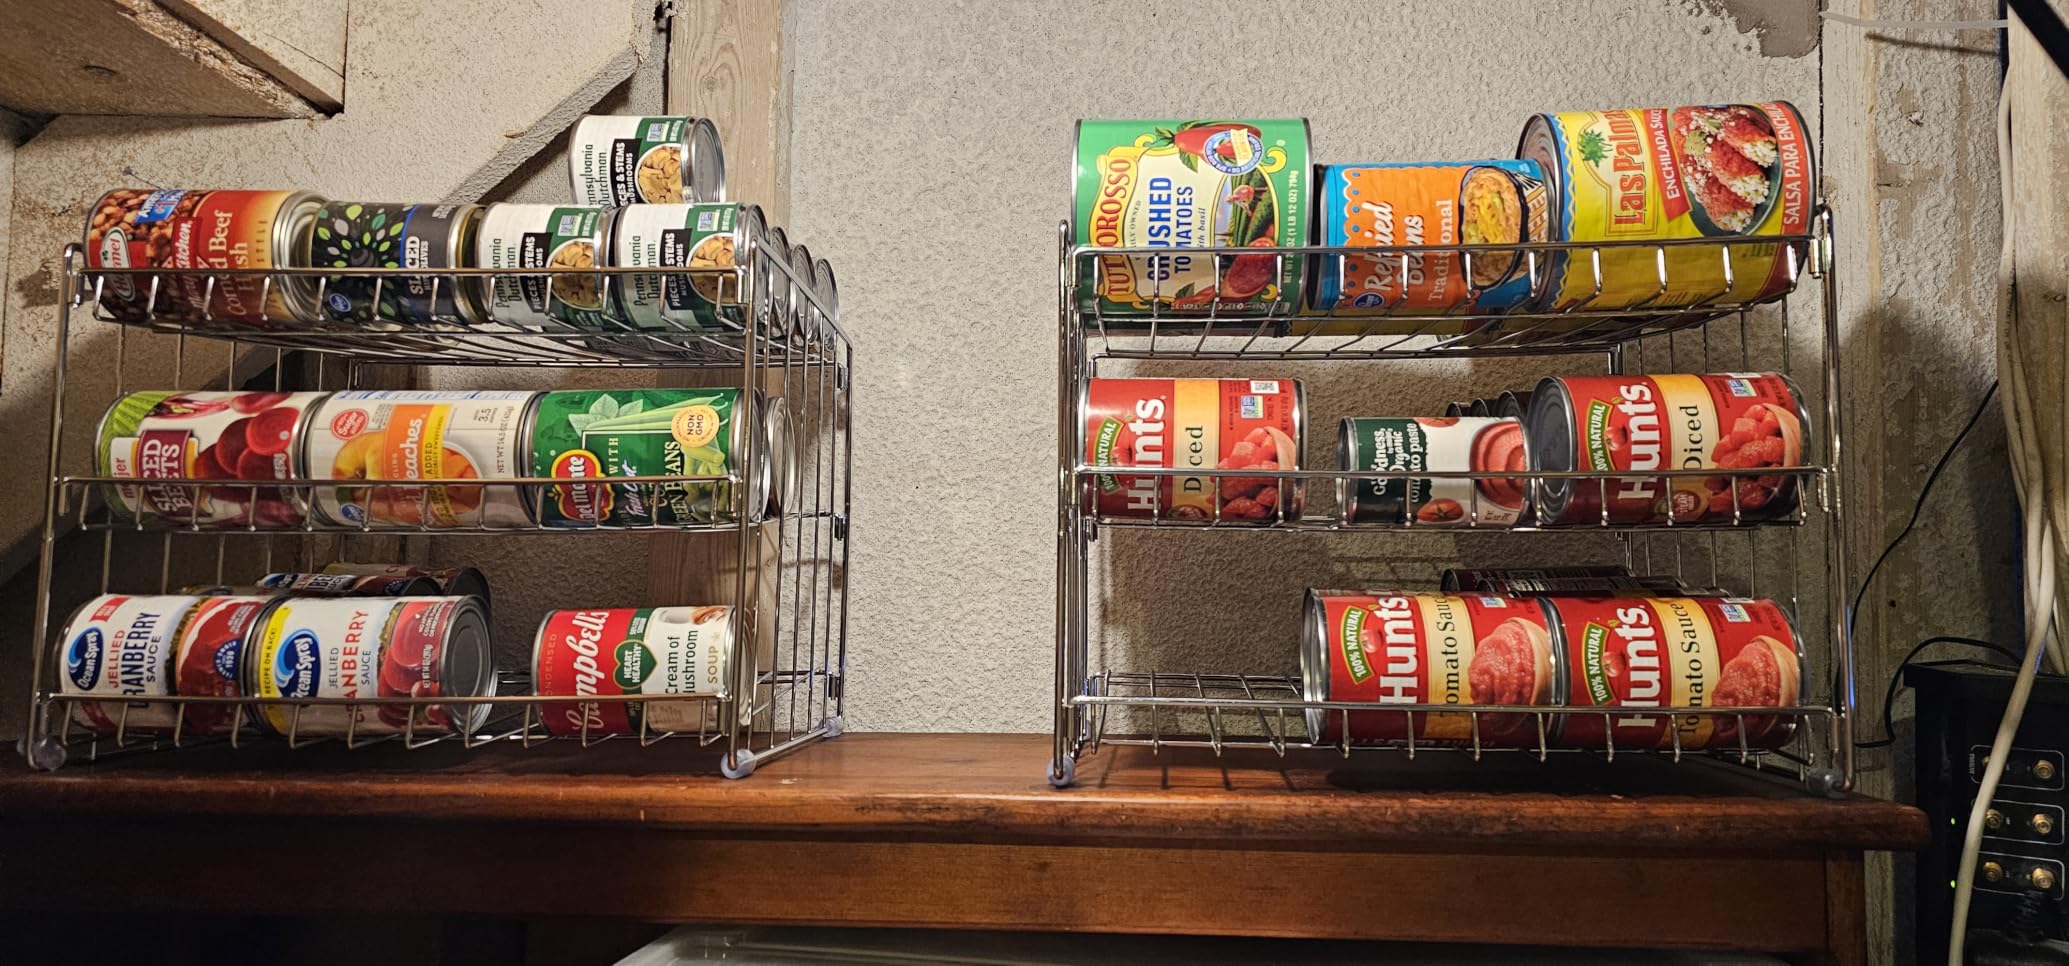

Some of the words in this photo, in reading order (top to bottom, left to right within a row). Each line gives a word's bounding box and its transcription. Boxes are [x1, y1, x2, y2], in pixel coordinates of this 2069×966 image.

[580, 144, 596, 205] nnsylvania
[616, 142, 627, 173] STEMS
[1653, 129, 1681, 199] ENCHILADA
[1781, 142, 1802, 179] PARA
[616, 183, 629, 206] ECES
[1613, 174, 1648, 226] Las
[1781, 179, 1802, 226] SALSA
[208, 209, 233, 252] Beef
[1096, 157, 1132, 295] TUTOROSSO
[1196, 207, 1206, 232] basil
[110, 237, 132, 294] Homel
[230, 241, 254, 292] Hsh
[405, 235, 424, 295] SLCED
[525, 235, 535, 268] STEMS
[664, 231, 676, 267] STEMS
[1428, 199, 1454, 302] Traditonal
[489, 238, 510, 309] Pennsvania
[632, 234, 650, 307] Pennsvania
[667, 274, 682, 307] PIECES
[478, 408, 492, 423] 3.5
[686, 414, 696, 436] NON
[695, 414, 704, 436] GMO
[1589, 403, 1606, 449] NATURAL
[498, 448, 505, 460] WT
[608, 437, 619, 475] WITH
[1097, 422, 1116, 468] NATURAL
[1406, 422, 1424, 453] paste
[1680, 404, 1703, 470] Diced
[114, 457, 137, 499] mjer
[425, 442, 434, 475] ADDED
[497, 460, 506, 474] NET
[1183, 425, 1203, 493] Dced
[83, 630, 100, 660] Spray
[667, 636, 680, 648] of
[1346, 609, 1363, 650] NATURAL
[1669, 602, 1702, 654] Sauce
[107, 629, 125, 689] JELLIED
[145, 635, 162, 683] SAUCE
[293, 637, 317, 671] Spray
[328, 646, 340, 690] JELLIED
[361, 649, 372, 686] SAUCE
[544, 633, 557, 697] ONDENSED
[623, 650, 633, 679] HEART
[631, 643, 643, 683] HEALTHY
[708, 645, 719, 684] SOUP
[1350, 650, 1367, 678] 100%
[1586, 627, 1603, 674] NATURAL
[77, 658, 97, 688] Ocean
[665, 653, 679, 694] Cream
[1590, 675, 1608, 702] 100%
